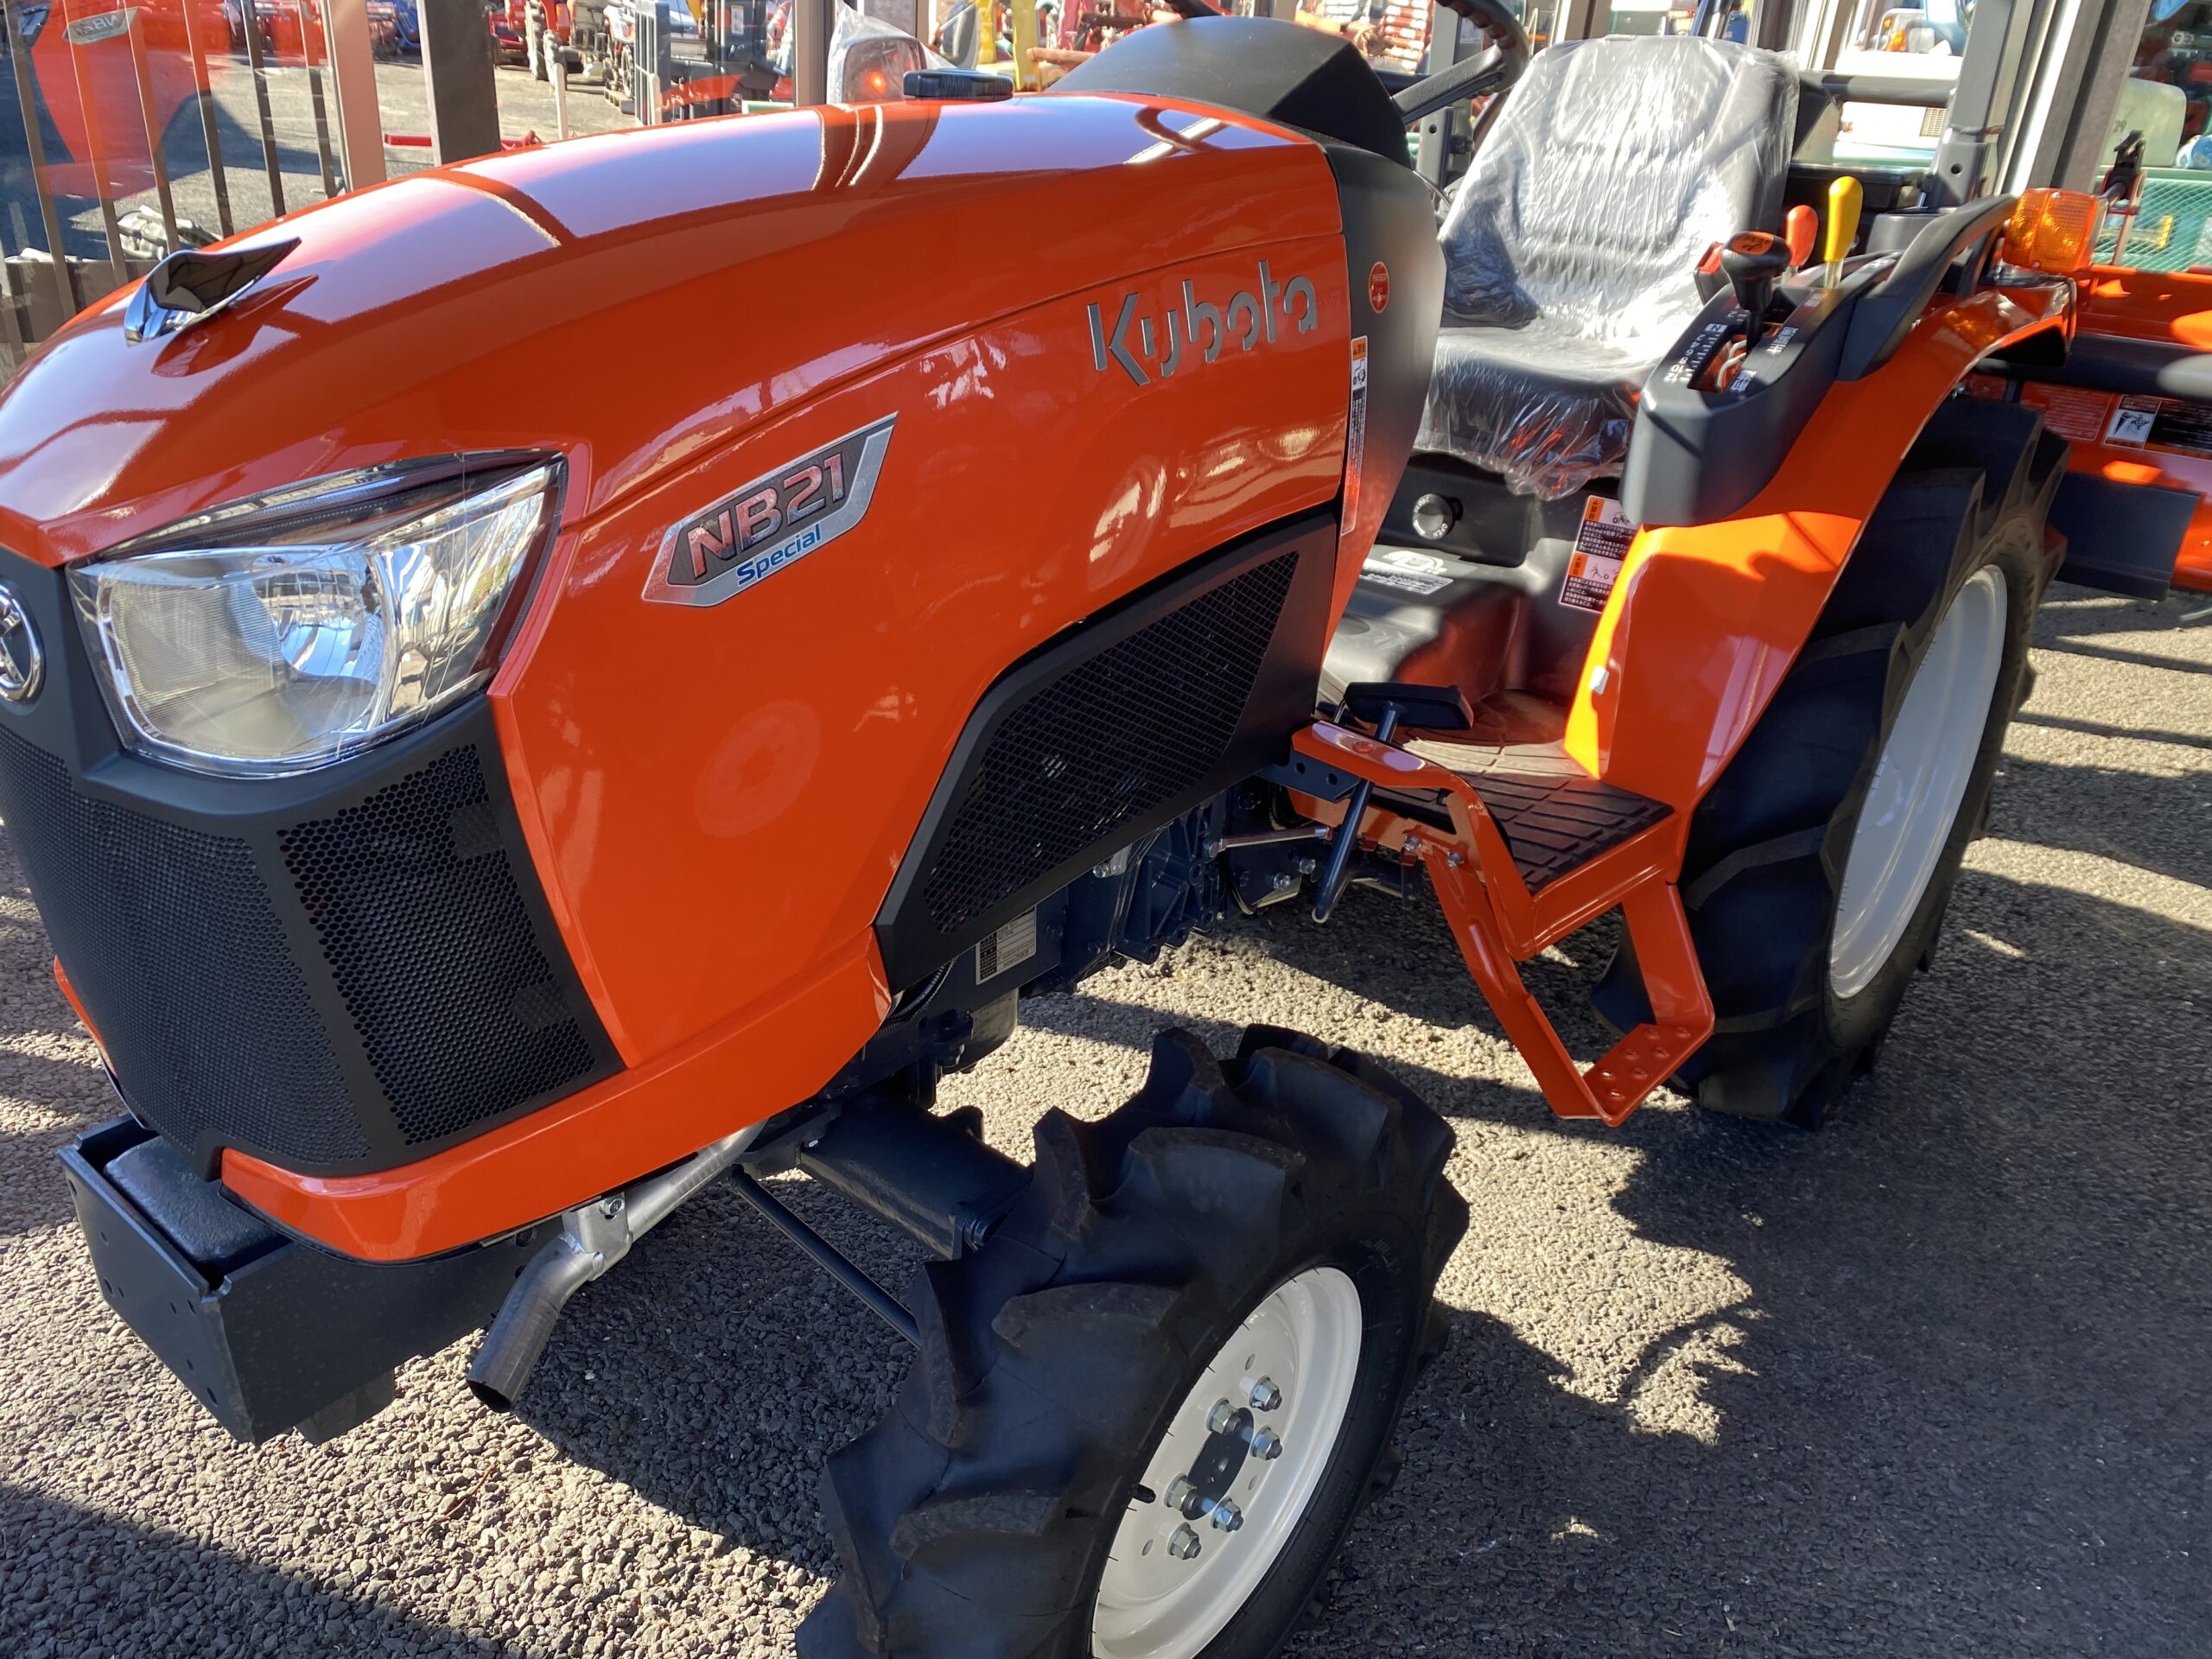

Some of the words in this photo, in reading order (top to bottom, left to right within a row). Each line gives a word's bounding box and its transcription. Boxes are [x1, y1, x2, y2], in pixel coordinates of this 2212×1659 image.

[1087, 258, 1318, 386] Kubota
[687, 452, 847, 579] NB21
[735, 524, 822, 586] Special
